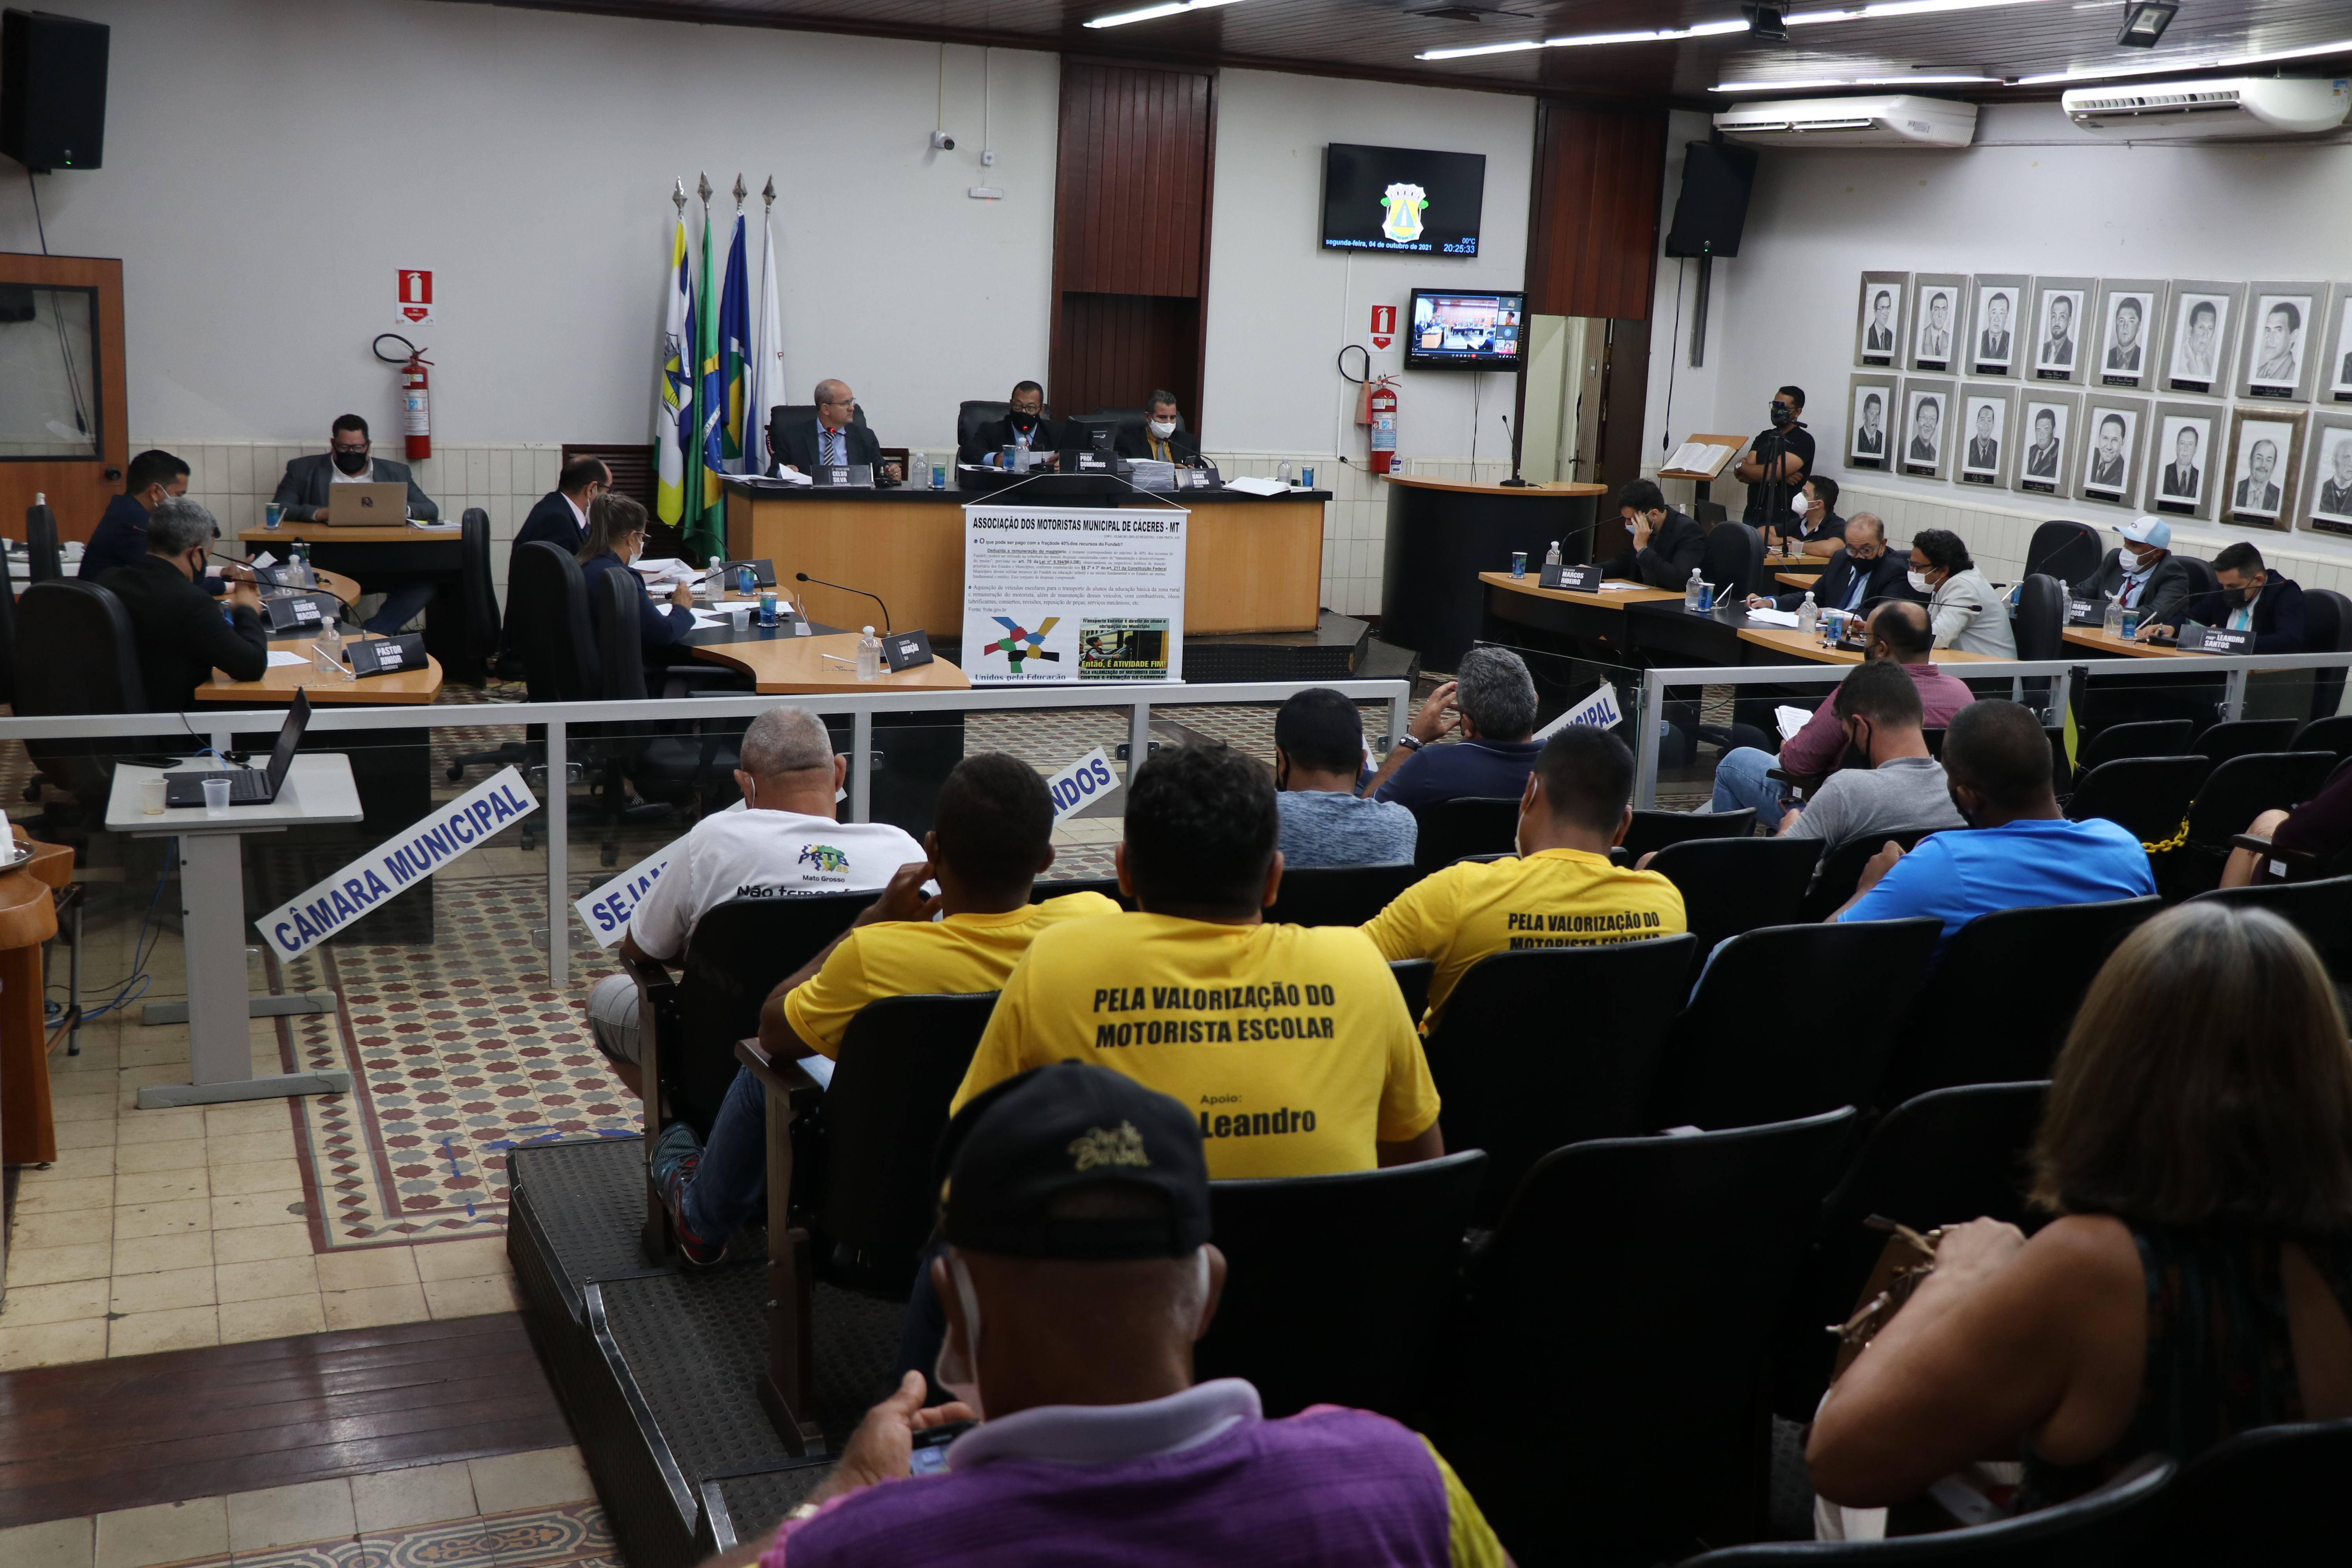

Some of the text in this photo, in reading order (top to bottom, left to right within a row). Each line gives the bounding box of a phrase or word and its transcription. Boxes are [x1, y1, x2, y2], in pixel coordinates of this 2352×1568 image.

[1326, 239, 1368, 248] segunda-feira,
[1443, 243, 1475, 254] 20:25:33
[973, 516, 1019, 532] ASSOCIAÇÃO
[1021, 519, 1035, 530] DOS
[1037, 519, 1081, 531] MOTORISTAS
[1083, 520, 1120, 532] MUNICIPAL
[1122, 521, 1131, 532] DE
[1132, 519, 1164, 532] CÁCERES
[1169, 522, 1180, 533] MT
[294, 602, 317, 612] RUBENS
[296, 610, 321, 621] MACEDO
[2204, 640, 2230, 649] SANTOS
[2216, 634, 2245, 643] LEANDRO
[376, 644, 403, 656] PASTOR
[900, 642, 919, 654] NEGAÇÃO
[379, 655, 403, 666] JUNIOR
[1052, 759, 1110, 816] NDOS
[798, 852, 849, 866] PRTB
[275, 784, 529, 951] CÂMARA MUNICIPAL
[737, 885, 773, 898] Não
[1508, 911, 1660, 933] PELA VALORIZAÇÃO DO
[1094, 982, 1335, 1012] PELA VALORIZAÇÃO DO
[1096, 1017, 1334, 1048] MOTORISTA ESCOLAR
[1200, 1094, 1242, 1105] Apoio:
[1201, 1107, 1316, 1138] Leandro
